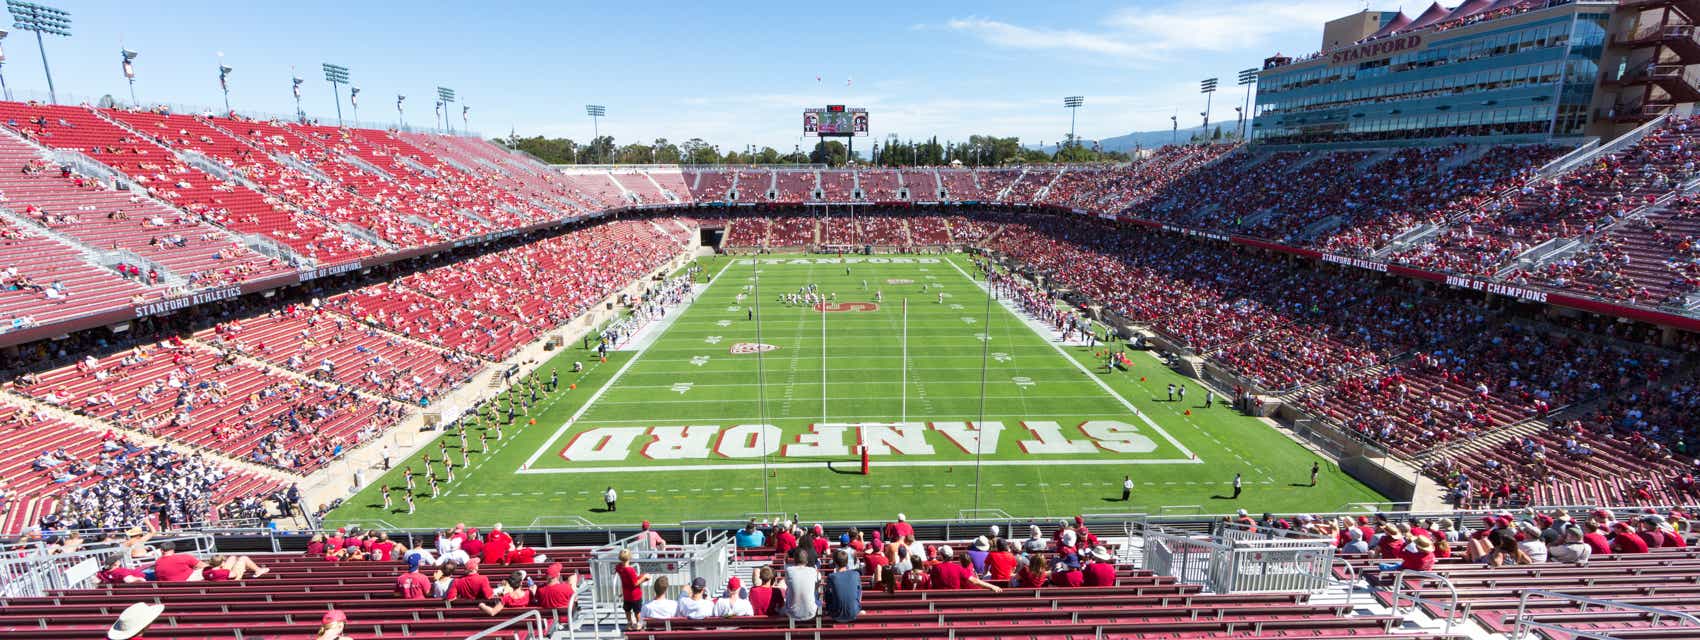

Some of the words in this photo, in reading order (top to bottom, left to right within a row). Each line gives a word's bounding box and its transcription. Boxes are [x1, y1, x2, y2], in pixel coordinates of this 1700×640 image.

[1332, 35, 1422, 63] STANFORD
[299, 270, 317, 282] HOME
[319, 268, 327, 277] OF
[1322, 253, 1351, 265] STANFORD
[1352, 259, 1388, 272] ATHLETICS
[135, 297, 190, 318] STANFORD
[193, 286, 241, 305] ATHLETICS
[1446, 275, 1470, 288] HOME
[1472, 280, 1486, 291] OF
[1487, 283, 1548, 303] CHAMPIONS
[560, 420, 1158, 460] STANFORD
